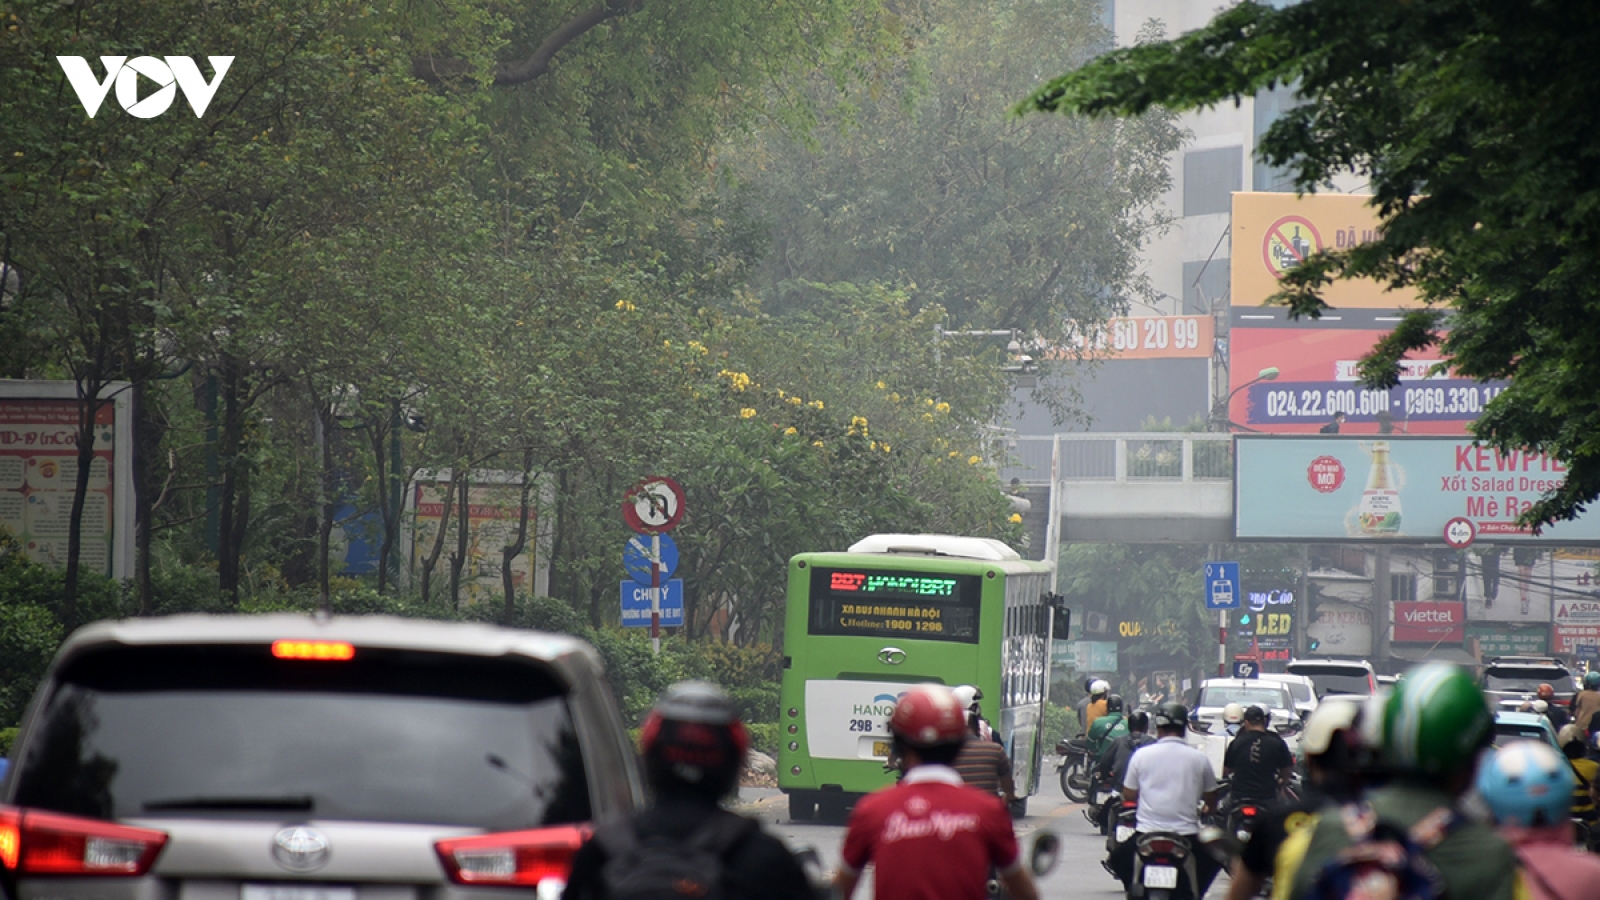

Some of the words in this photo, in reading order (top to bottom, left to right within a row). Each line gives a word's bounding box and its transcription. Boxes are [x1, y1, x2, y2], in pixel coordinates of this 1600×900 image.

[1335, 225, 1357, 248] ĐÃ
[1144, 318, 1169, 349] 20
[1173, 318, 1199, 349] 99
[1267, 388, 1390, 417] 024.22.600.600
[1404, 386, 1509, 415] 0969.330.1
[1317, 471, 1336, 485] MỚI
[1440, 474, 1467, 492] Xốt
[1471, 476, 1515, 492] Salad
[1519, 476, 1568, 492] Dress
[1466, 495, 1499, 518] Mè
[1505, 496, 1541, 518] Ra
[661, 584, 670, 601] Ý
[855, 604, 872, 616] BUS
[907, 605, 920, 617] HÀ
[921, 606, 941, 620] NỘI
[1403, 610, 1454, 623] viettel
[885, 619, 912, 631] 1900
[1256, 613, 1292, 636] LED
[853, 704, 896, 717] HANO
[849, 719, 873, 733] 29B
